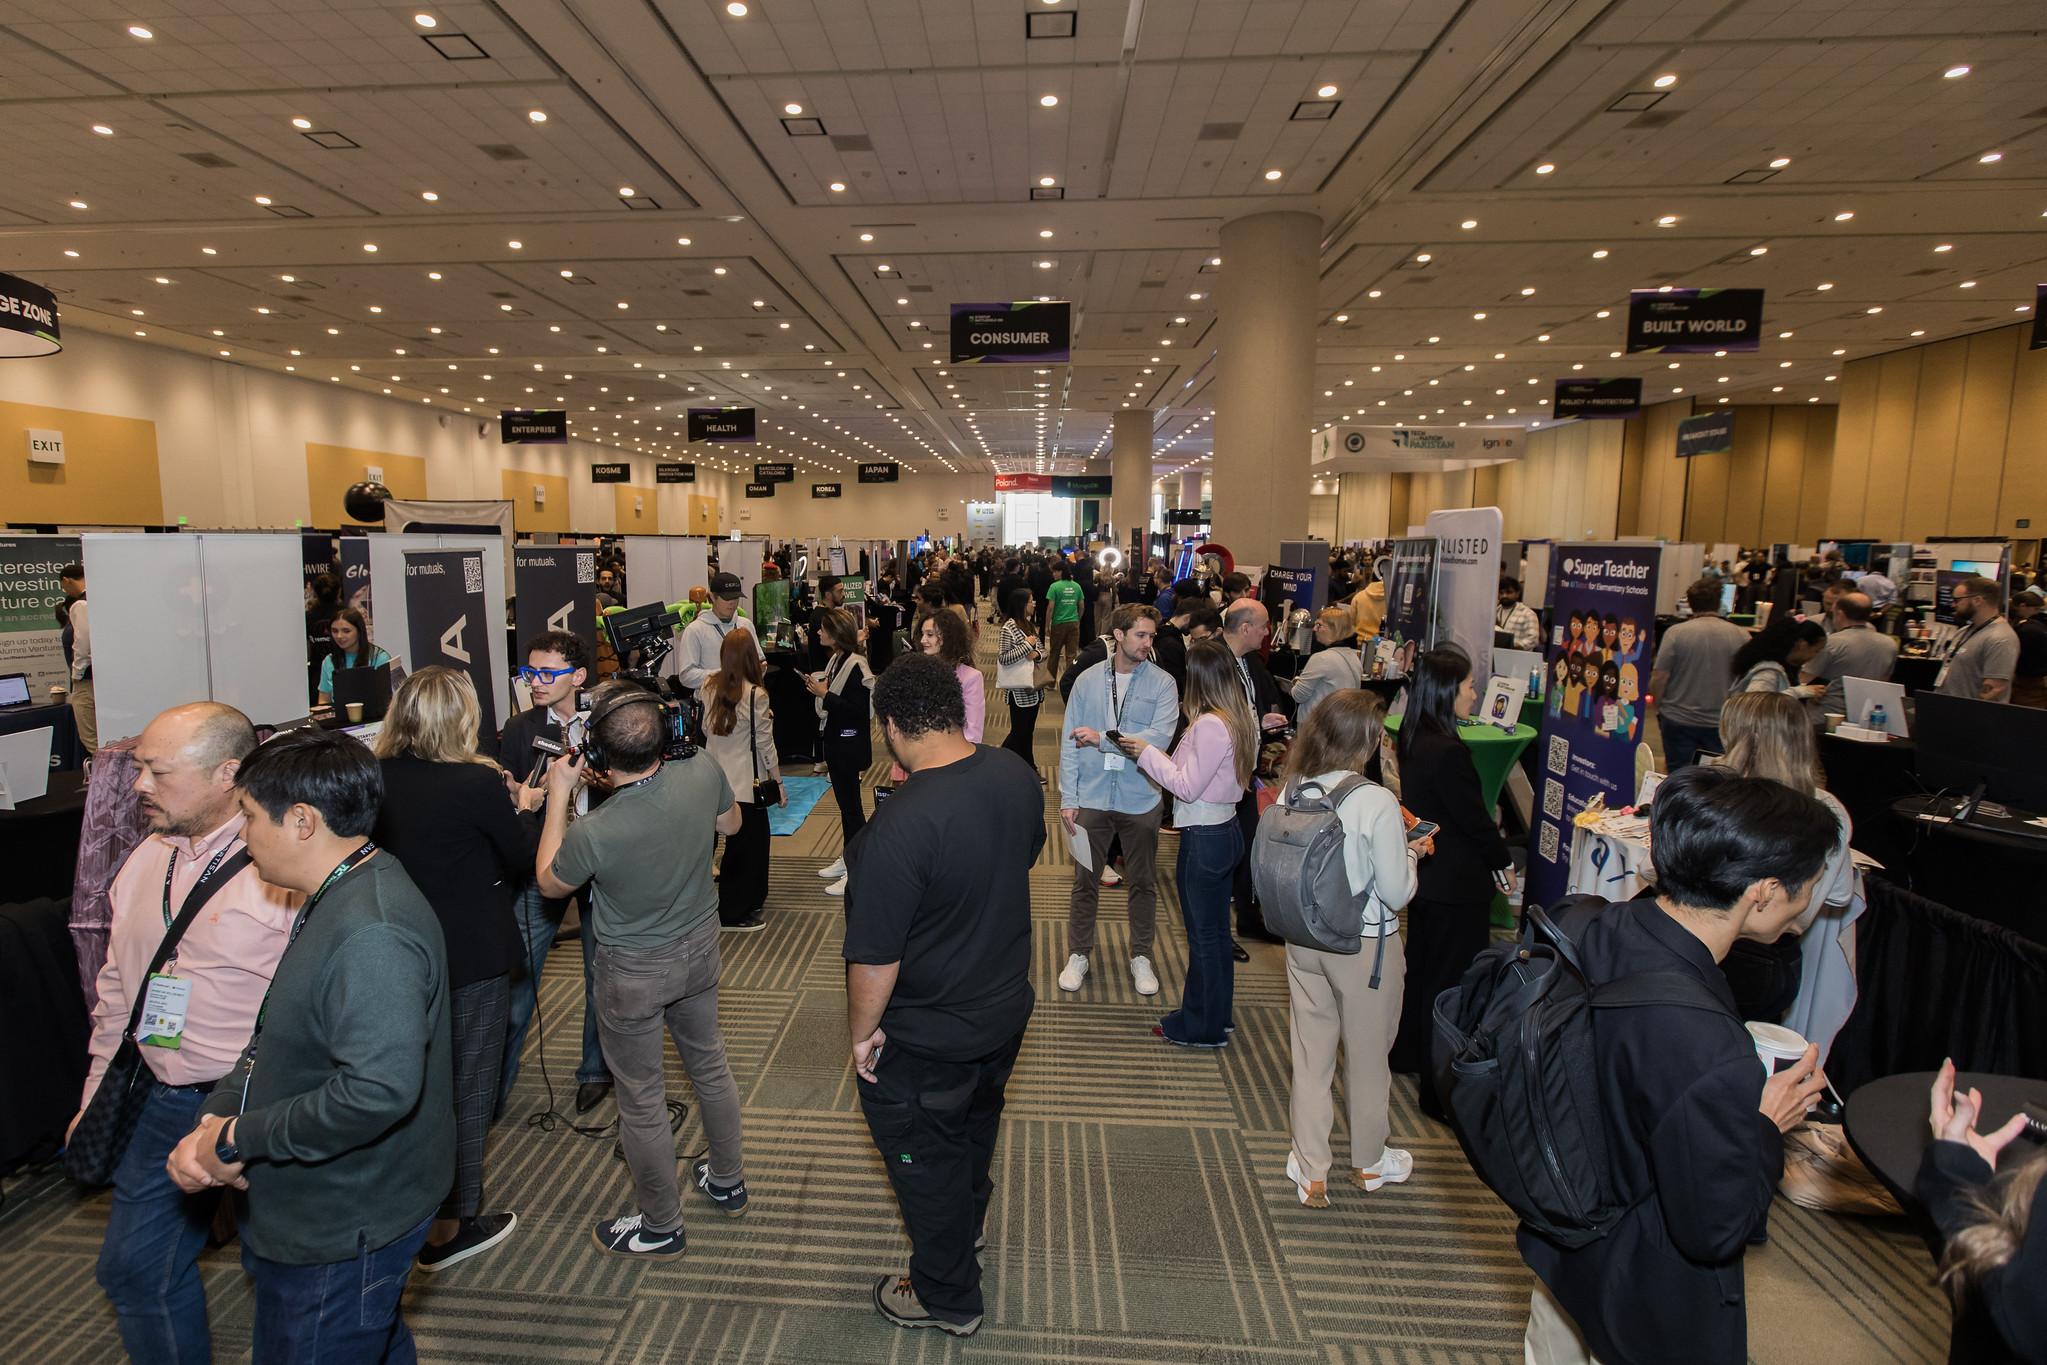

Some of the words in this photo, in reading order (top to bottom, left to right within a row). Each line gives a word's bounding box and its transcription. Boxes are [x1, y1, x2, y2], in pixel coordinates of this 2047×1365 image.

[21, 300, 53, 327] ZONE
[1643, 320, 1685, 333] BUILT
[1687, 319, 1747, 332] WORLD
[970, 332, 1049, 344] CONSUMER
[32, 440, 61, 452] EXIT
[1409, 440, 1455, 449] PAKISTAN
[369, 473, 382, 482] EXIT
[995, 478, 1018, 487] Poland.
[516, 557, 526, 567] for
[528, 556, 557, 567] mutuals,
[406, 563, 418, 576] for
[419, 562, 446, 577] mutuals,
[1573, 558, 1604, 580] Super
[1604, 560, 1650, 579] Teacher
[1270, 569, 1294, 580] CHARGE
[1296, 572, 1312, 582] YOUR
[1283, 582, 1298, 592] MIND
[1561, 579, 1570, 587] The
[1588, 582, 1596, 590] for
[1596, 583, 1626, 595] Elementary
[1626, 586, 1648, 595] Schools
[1, 597, 39, 610] ture
[30, 637, 54, 645] today
[357, 732, 376, 740] STARTUP
[537, 739, 562, 751] cheddar
[1571, 764, 1579, 773] Get
[1579, 767, 1584, 775] in
[1584, 770, 1600, 783] touch
[1610, 782, 1618, 791] us
[731, 1185, 744, 1197] NIKE
